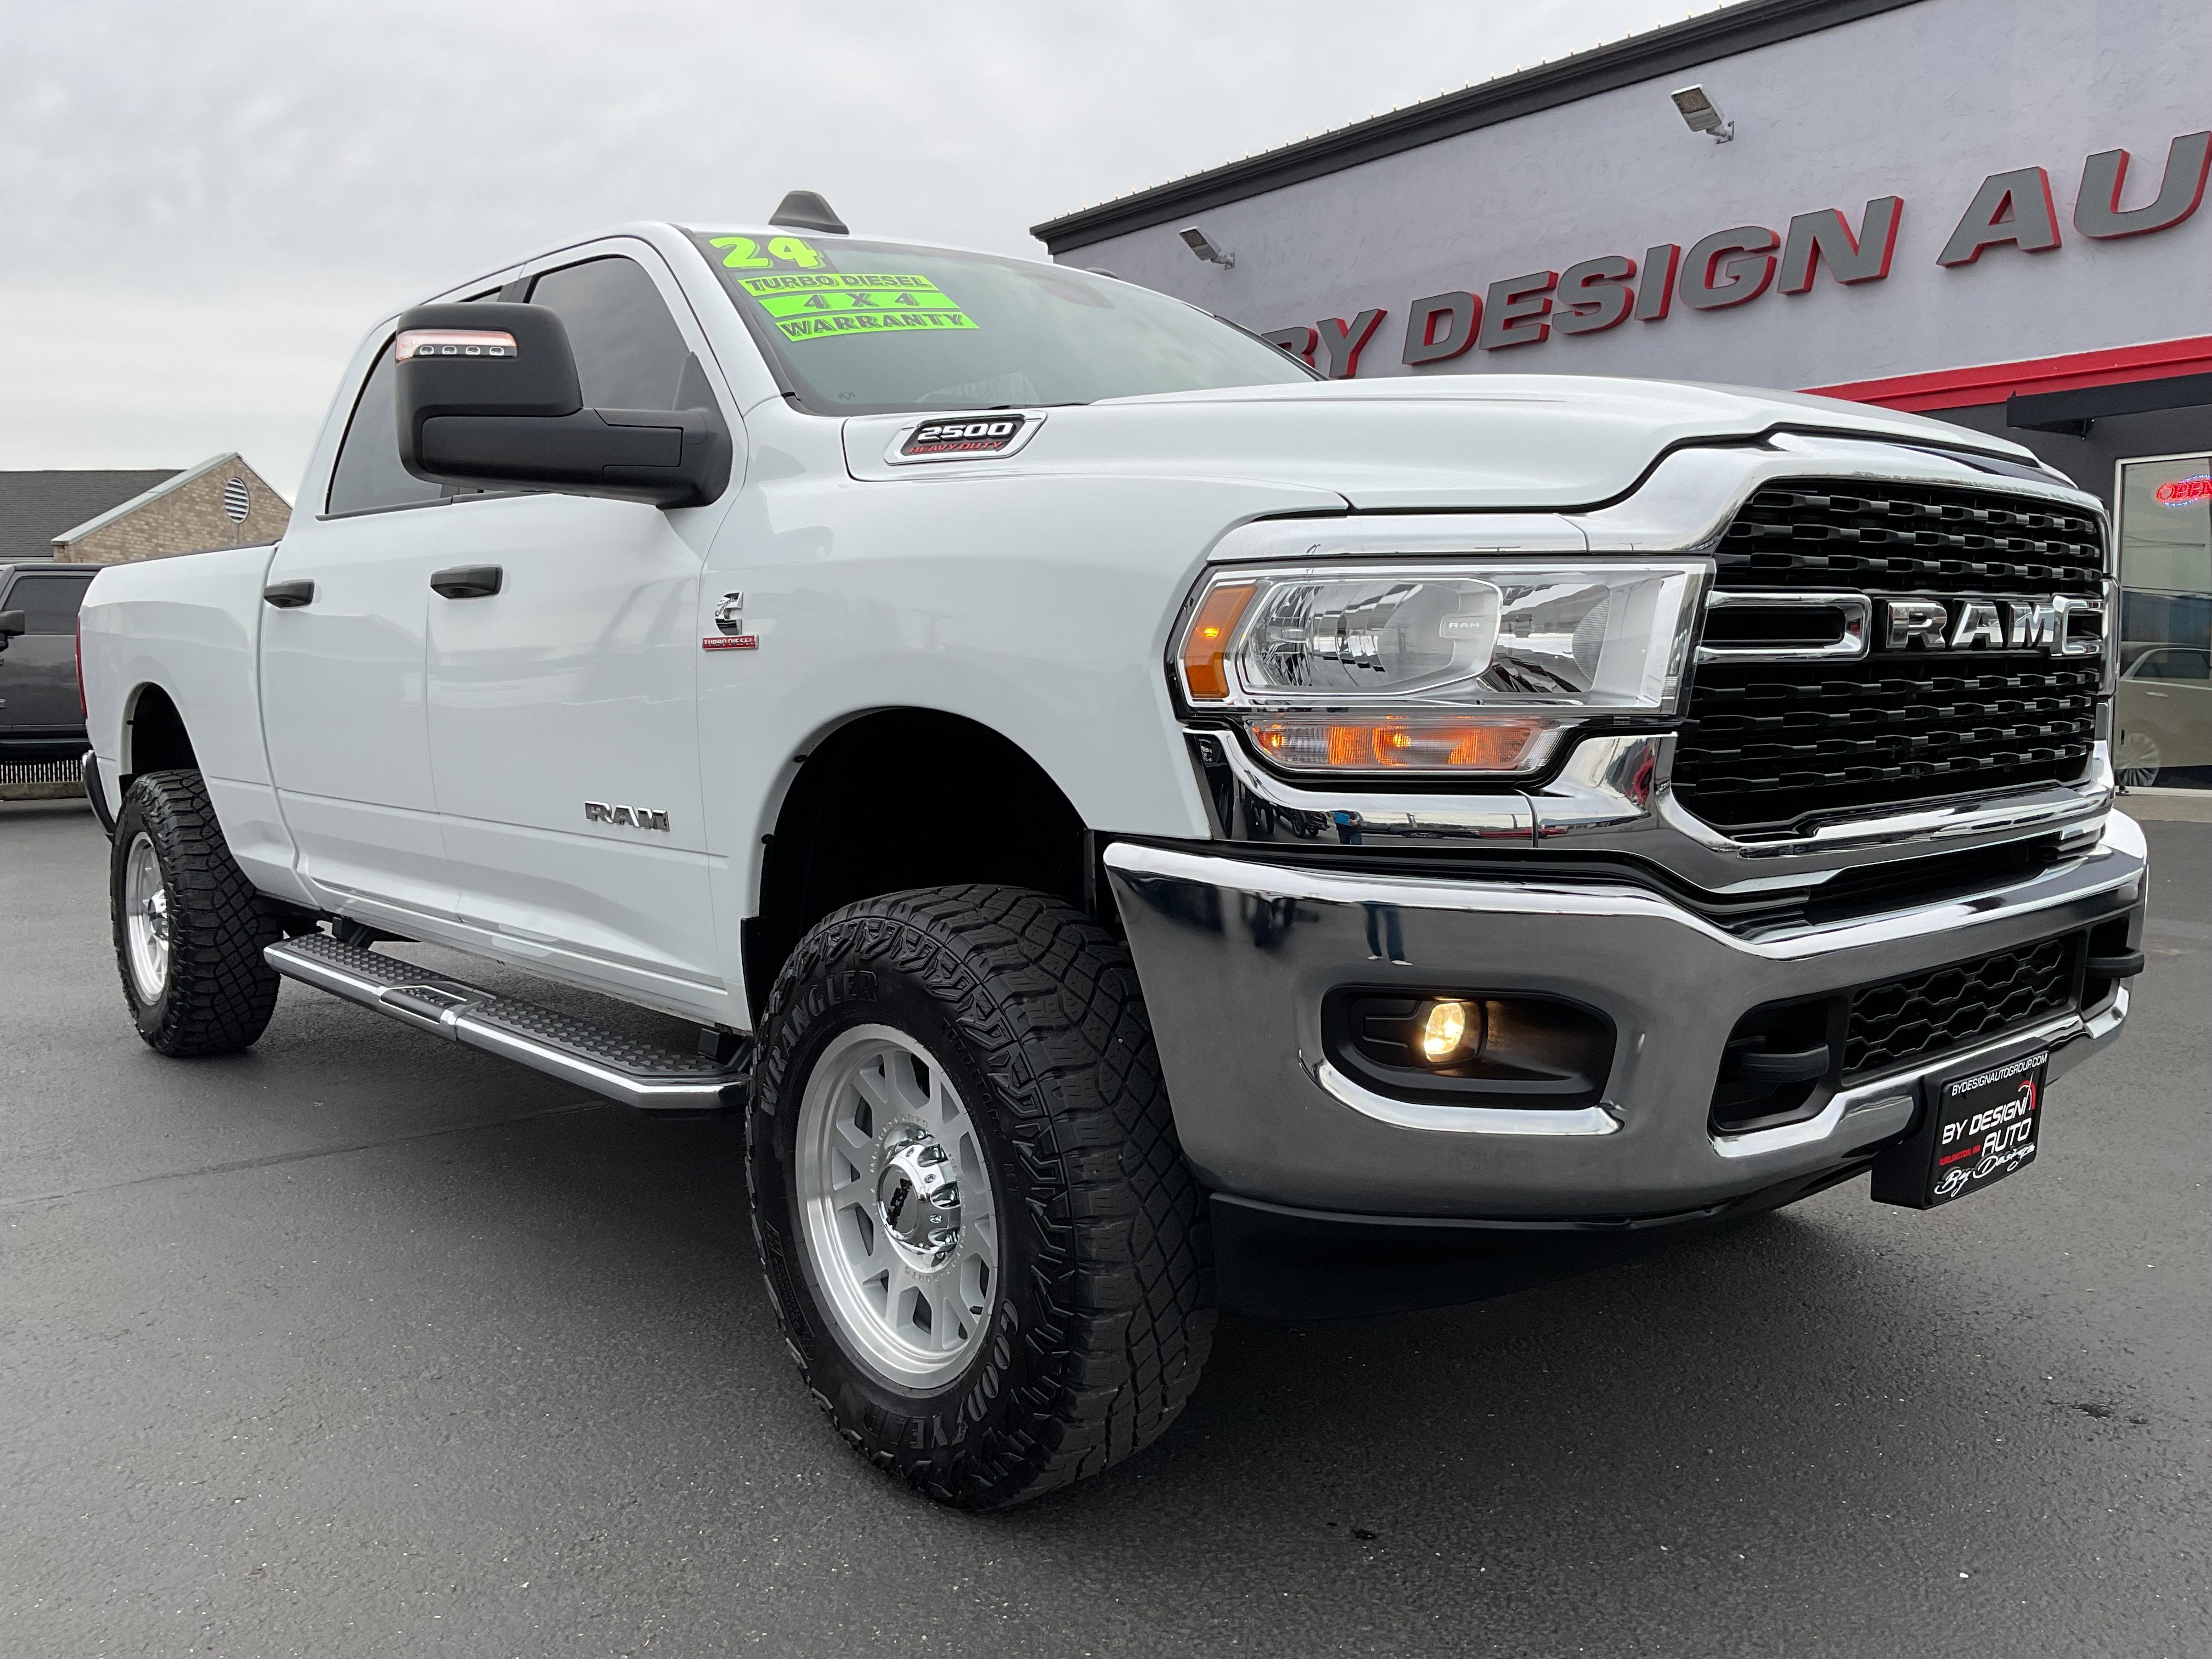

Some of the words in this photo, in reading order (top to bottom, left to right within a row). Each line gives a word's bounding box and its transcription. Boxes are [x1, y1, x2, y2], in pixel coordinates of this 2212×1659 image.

[709, 237, 823, 268] 24
[1402, 195, 1904, 366] DESIGN
[1936, 130, 2212, 268] AU
[746, 275, 837, 291] TURBO
[840, 274, 930, 287] DIESEL
[804, 294, 826, 309] 4
[849, 292, 874, 307] X
[895, 292, 918, 306] 4
[781, 313, 962, 337] WARRANTY
[909, 443, 958, 454] HEAVY
[959, 441, 1005, 450] DUTY
[918, 422, 1015, 443] 2500
[1886, 601, 2054, 649] RAM
[584, 800, 670, 832] RAM
[760, 970, 878, 1116] WRANGLER
[1951, 1053, 2048, 1096] BYDESIGNAUTOGROUP.COM
[1942, 1119, 1968, 1144] BY
[1968, 1097, 2028, 1136] DESIGN
[1982, 1118, 2032, 1157] AUTO
[1934, 1168, 1971, 1197] By
[862, 1299, 1019, 1449] GOODYEAR
